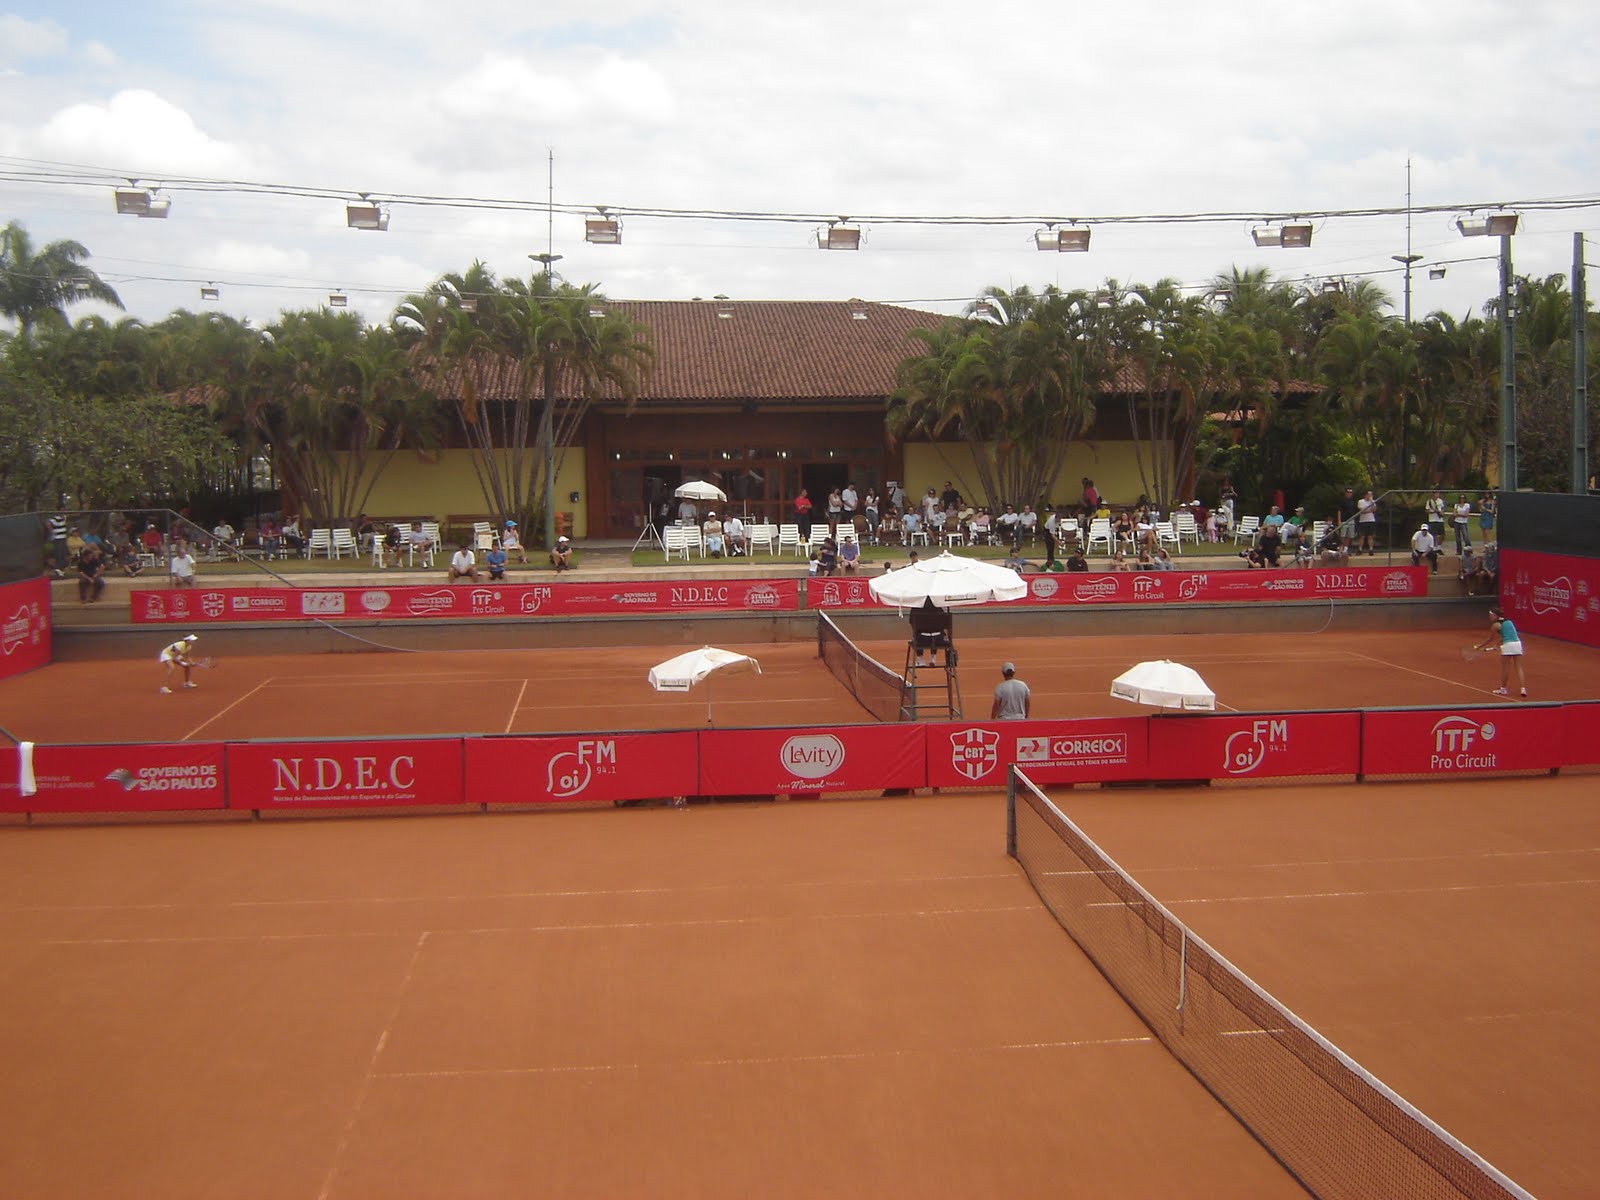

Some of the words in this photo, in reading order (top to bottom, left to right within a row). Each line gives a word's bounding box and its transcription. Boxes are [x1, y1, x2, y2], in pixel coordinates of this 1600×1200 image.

[1134, 581, 1153, 591] ITF
[1191, 574, 1208, 585] FM
[1315, 574, 1367, 588] N.D.E.C
[471, 594, 492, 605] ITF
[533, 587, 551, 599] FM
[671, 586, 729, 602] N.D.E.C
[1253, 720, 1287, 742] FM
[1053, 739, 1121, 755] CORREIOS
[1269, 744, 1287, 752] 94.1
[1436, 729, 1476, 752] ITF
[578, 740, 616, 764] FM
[965, 747, 985, 759] CBT
[1235, 747, 1253, 766] oi
[1431, 755, 1452, 769] Pro
[1456, 753, 1496, 768] Circuit
[139, 766, 199, 778] GOVERNO
[200, 765, 217, 776] DE
[272, 755, 415, 791] N.D.E.C
[596, 766, 616, 774] 94.1
[139, 776, 171, 792] SÃO
[171, 777, 217, 790] PAULO
[560, 769, 578, 789] oi
